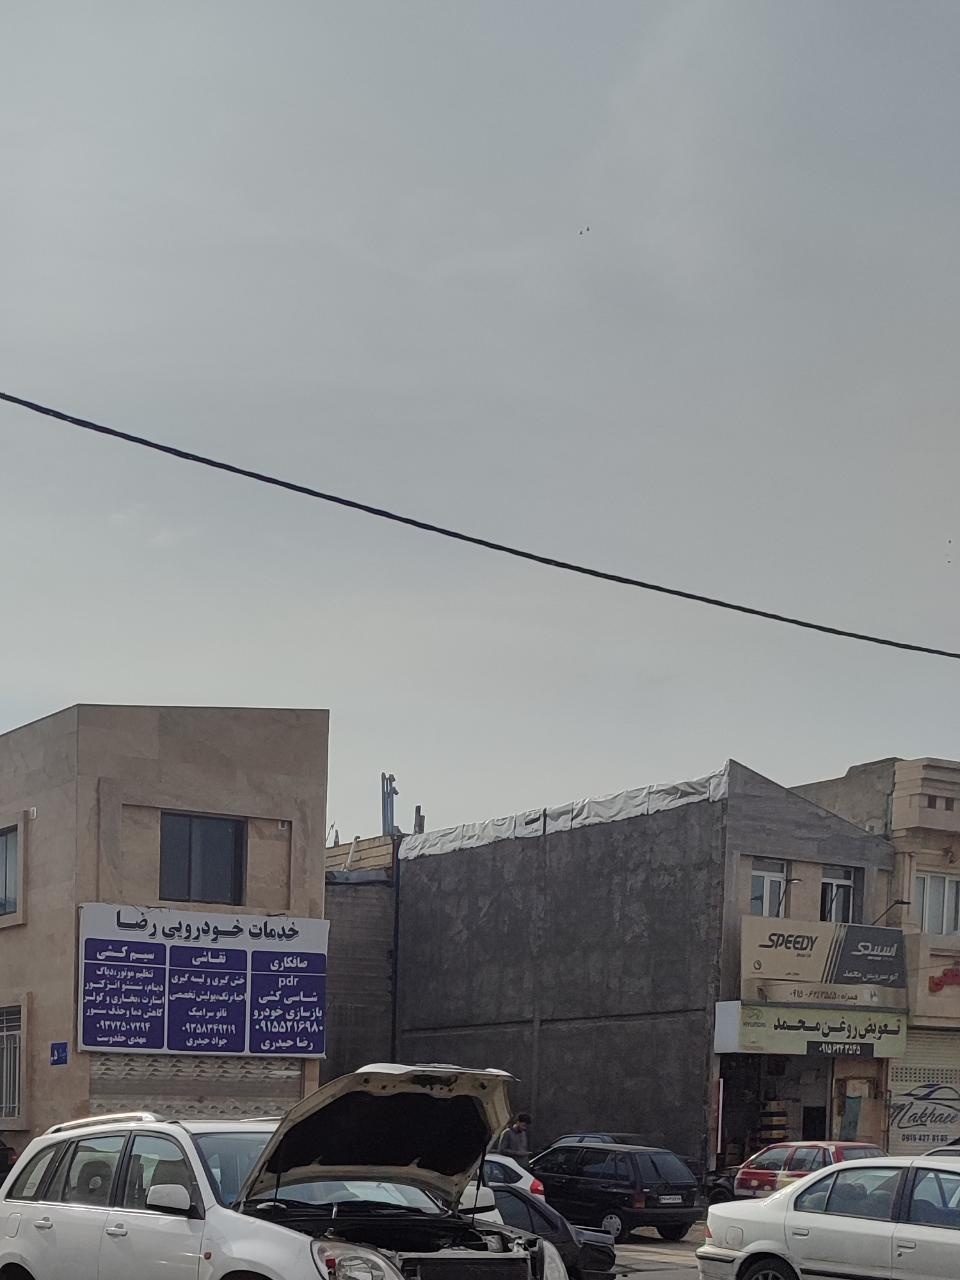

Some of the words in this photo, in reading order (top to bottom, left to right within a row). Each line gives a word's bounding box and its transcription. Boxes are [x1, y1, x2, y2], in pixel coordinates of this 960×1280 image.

[116, 910, 157, 938] رضا
[161, 919, 244, 943] خودرویی
[248, 920, 299, 940] خدمات
[758, 932, 819, 951] SPEEDY
[96, 945, 128, 960] کشی
[130, 950, 155, 961] سیم
[191, 951, 227, 965] نقاشی
[270, 956, 308, 971] صافکاری
[278, 976, 299, 988] pdr
[258, 990, 282, 1004] کشی
[283, 990, 318, 1004] شاسی
[252, 1007, 284, 1020] خودرو
[285, 1006, 323, 1020] بازسازی
[773, 1017, 821, 1032] محمد
[821, 1016, 858, 1040] روغن
[859, 1018, 903, 1040] تعویض
[260, 1038, 294, 1050] حیدری
[296, 1037, 314, 1050] رضا
